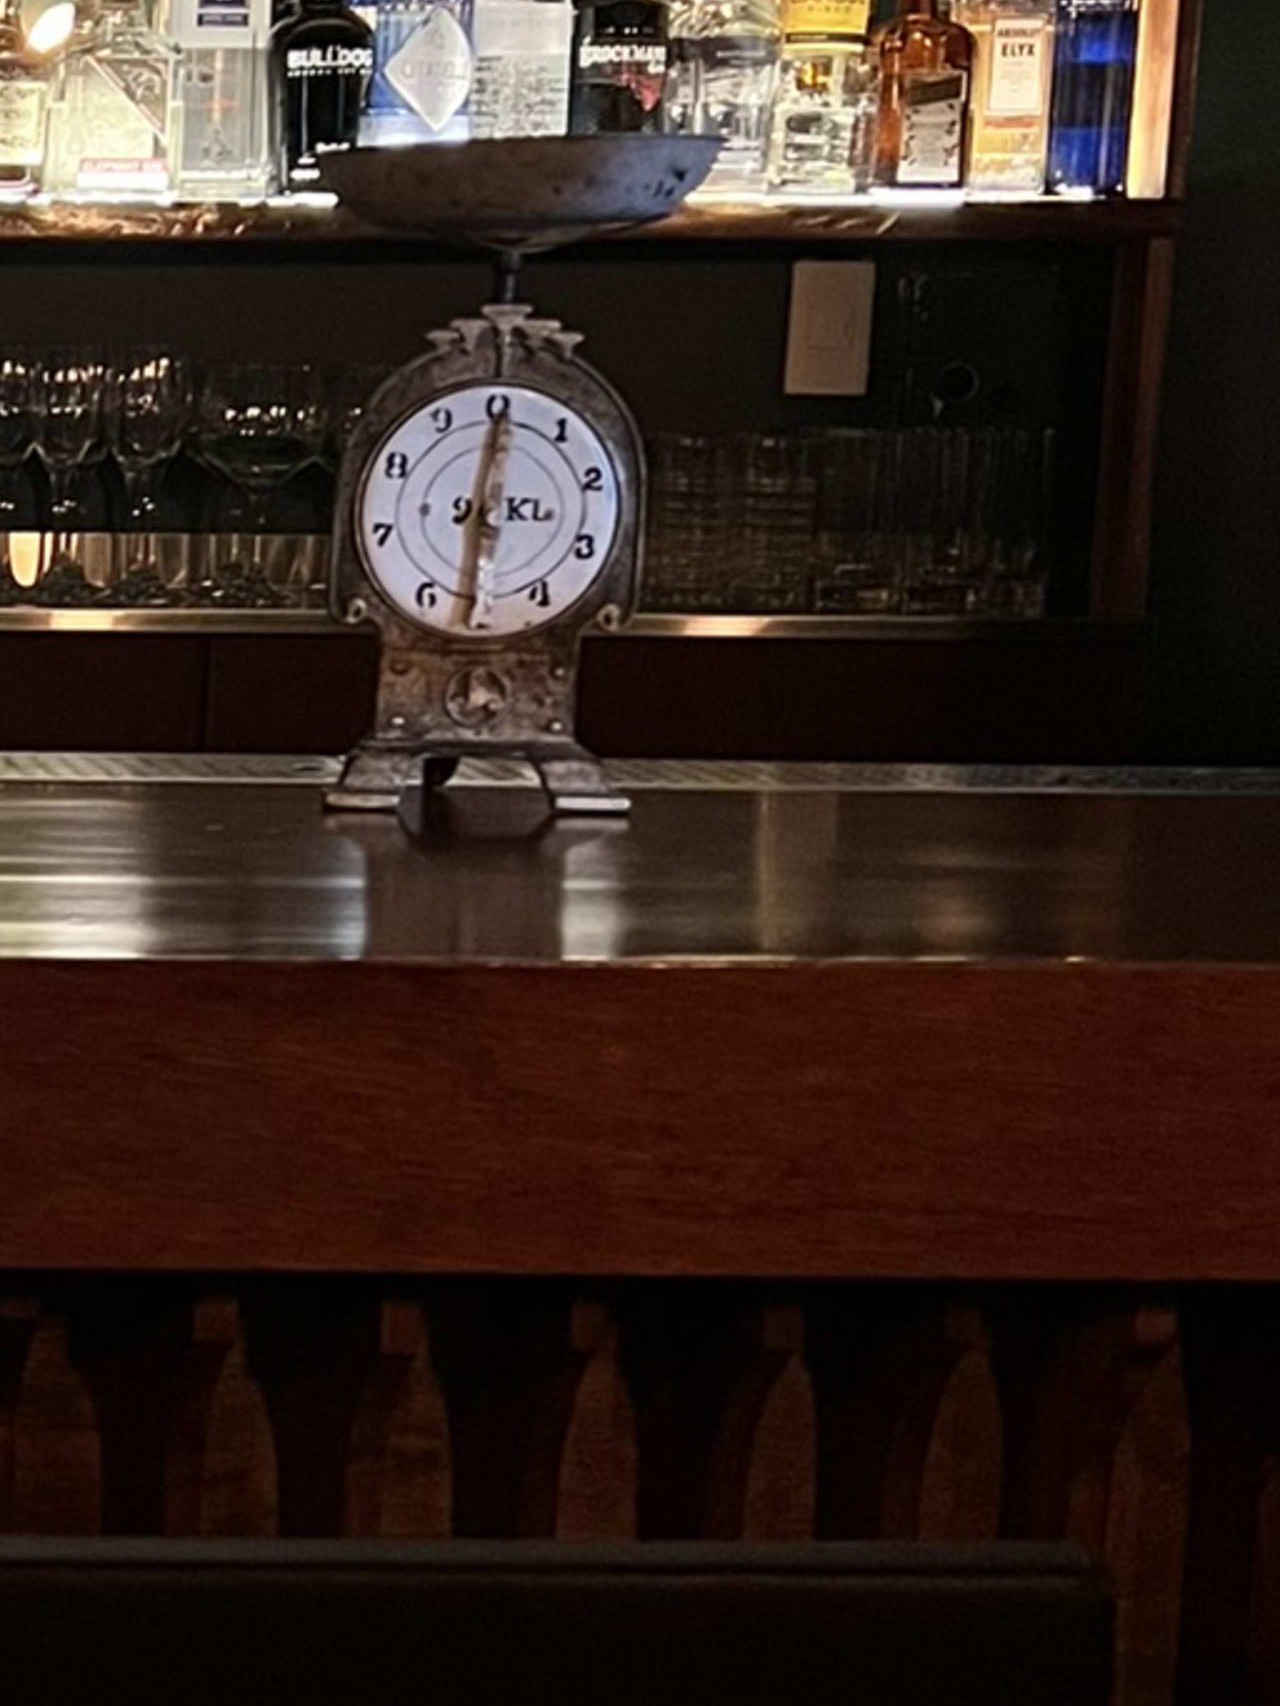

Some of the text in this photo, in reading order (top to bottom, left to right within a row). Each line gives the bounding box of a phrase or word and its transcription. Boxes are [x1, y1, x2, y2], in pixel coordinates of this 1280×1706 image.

[1000, 43, 1036, 58] ELYX
[429, 407, 453, 433] 9
[485, 394, 510, 421] 0
[553, 417, 569, 443] 1
[384, 451, 409, 479] 8
[583, 466, 604, 492] 2
[372, 521, 394, 548] 7
[573, 533, 596, 560] 3
[415, 580, 437, 609] 6
[527, 579, 551, 607] 4
